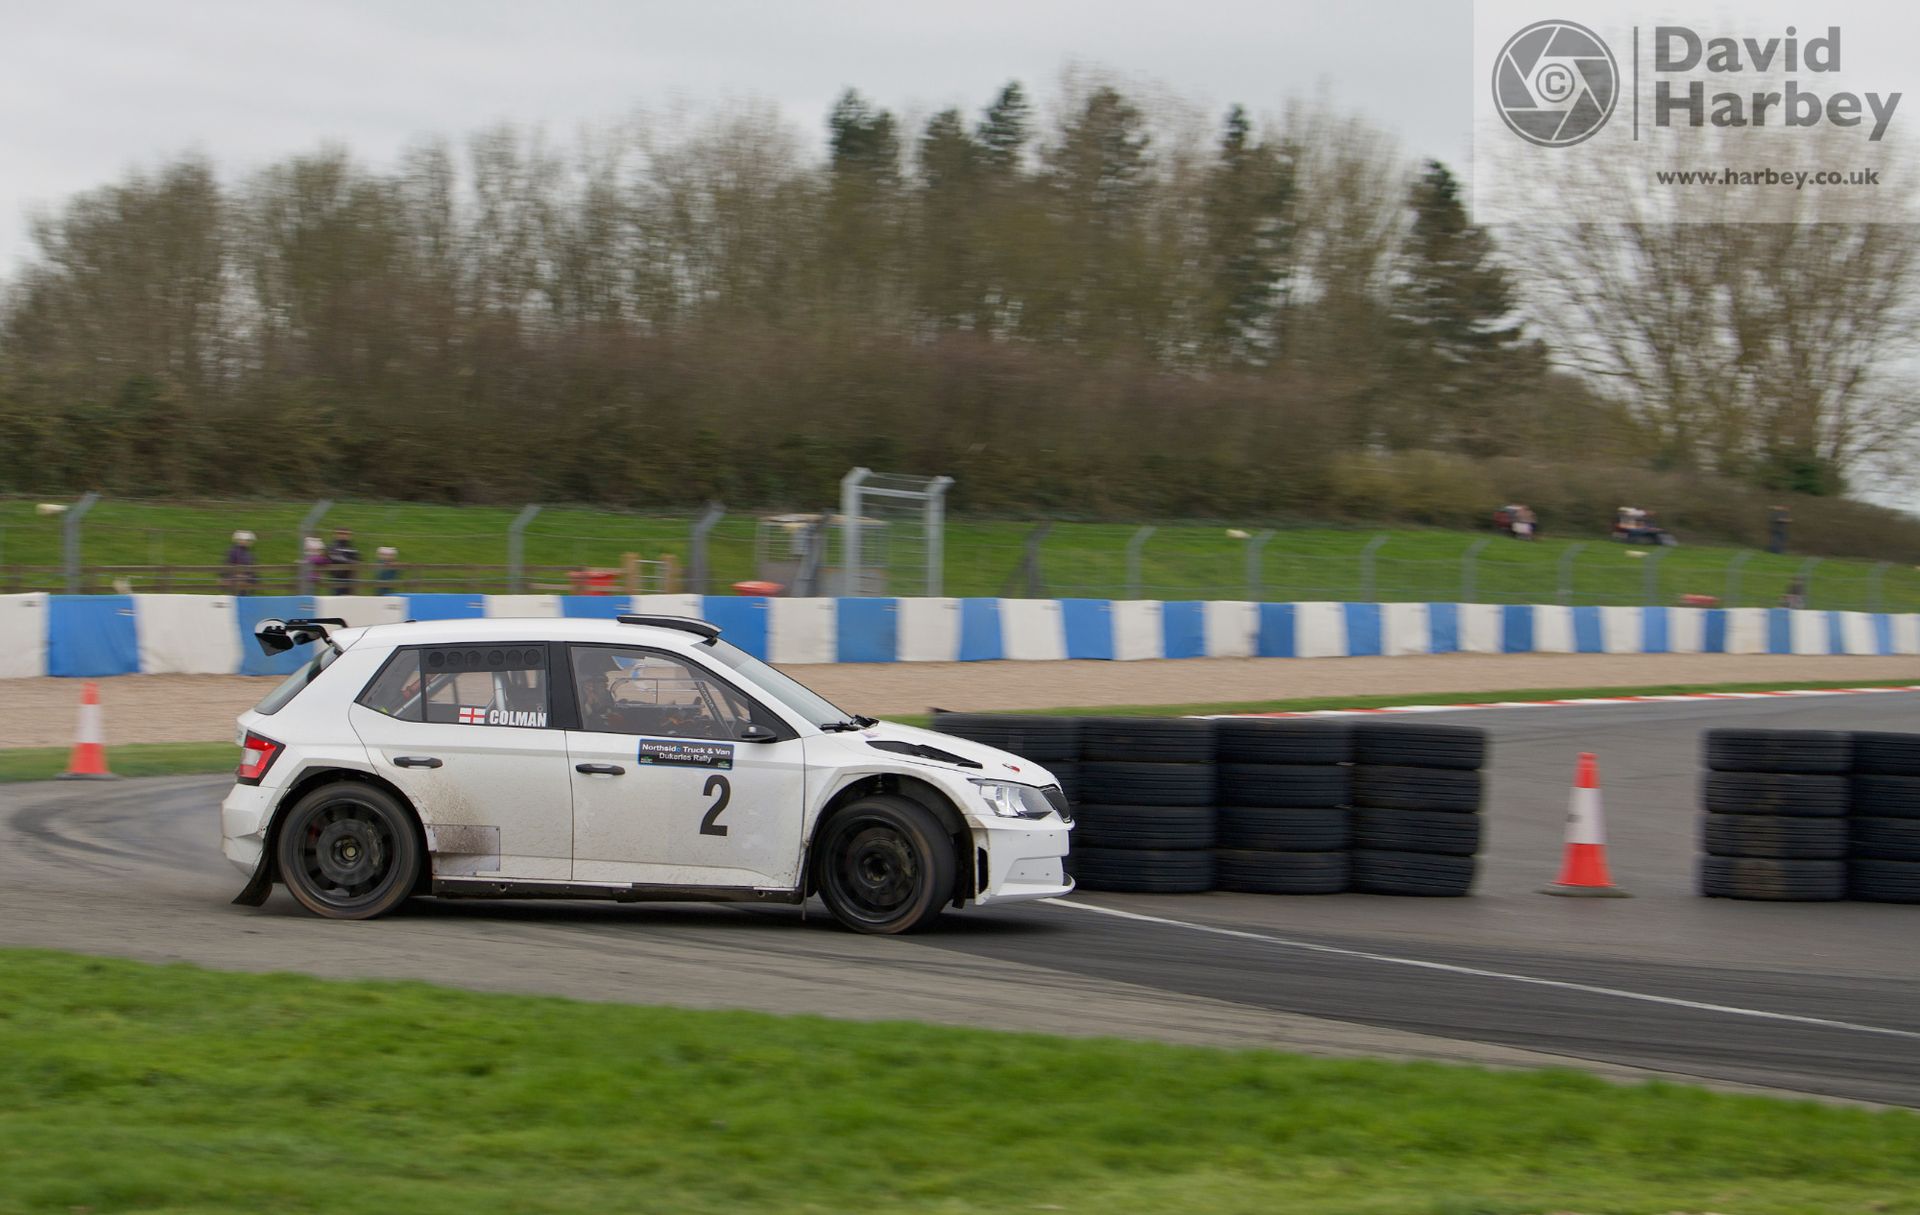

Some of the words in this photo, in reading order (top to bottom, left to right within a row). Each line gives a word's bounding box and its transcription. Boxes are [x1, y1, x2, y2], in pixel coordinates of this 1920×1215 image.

[490, 710, 547, 727] COLMAN
[642, 744, 681, 752] Northside
[683, 746, 706, 754] Truck
[715, 748, 731, 756] Van
[659, 752, 692, 761] Dukeries
[693, 754, 713, 764] Rally
[699, 774, 731, 836] 2
